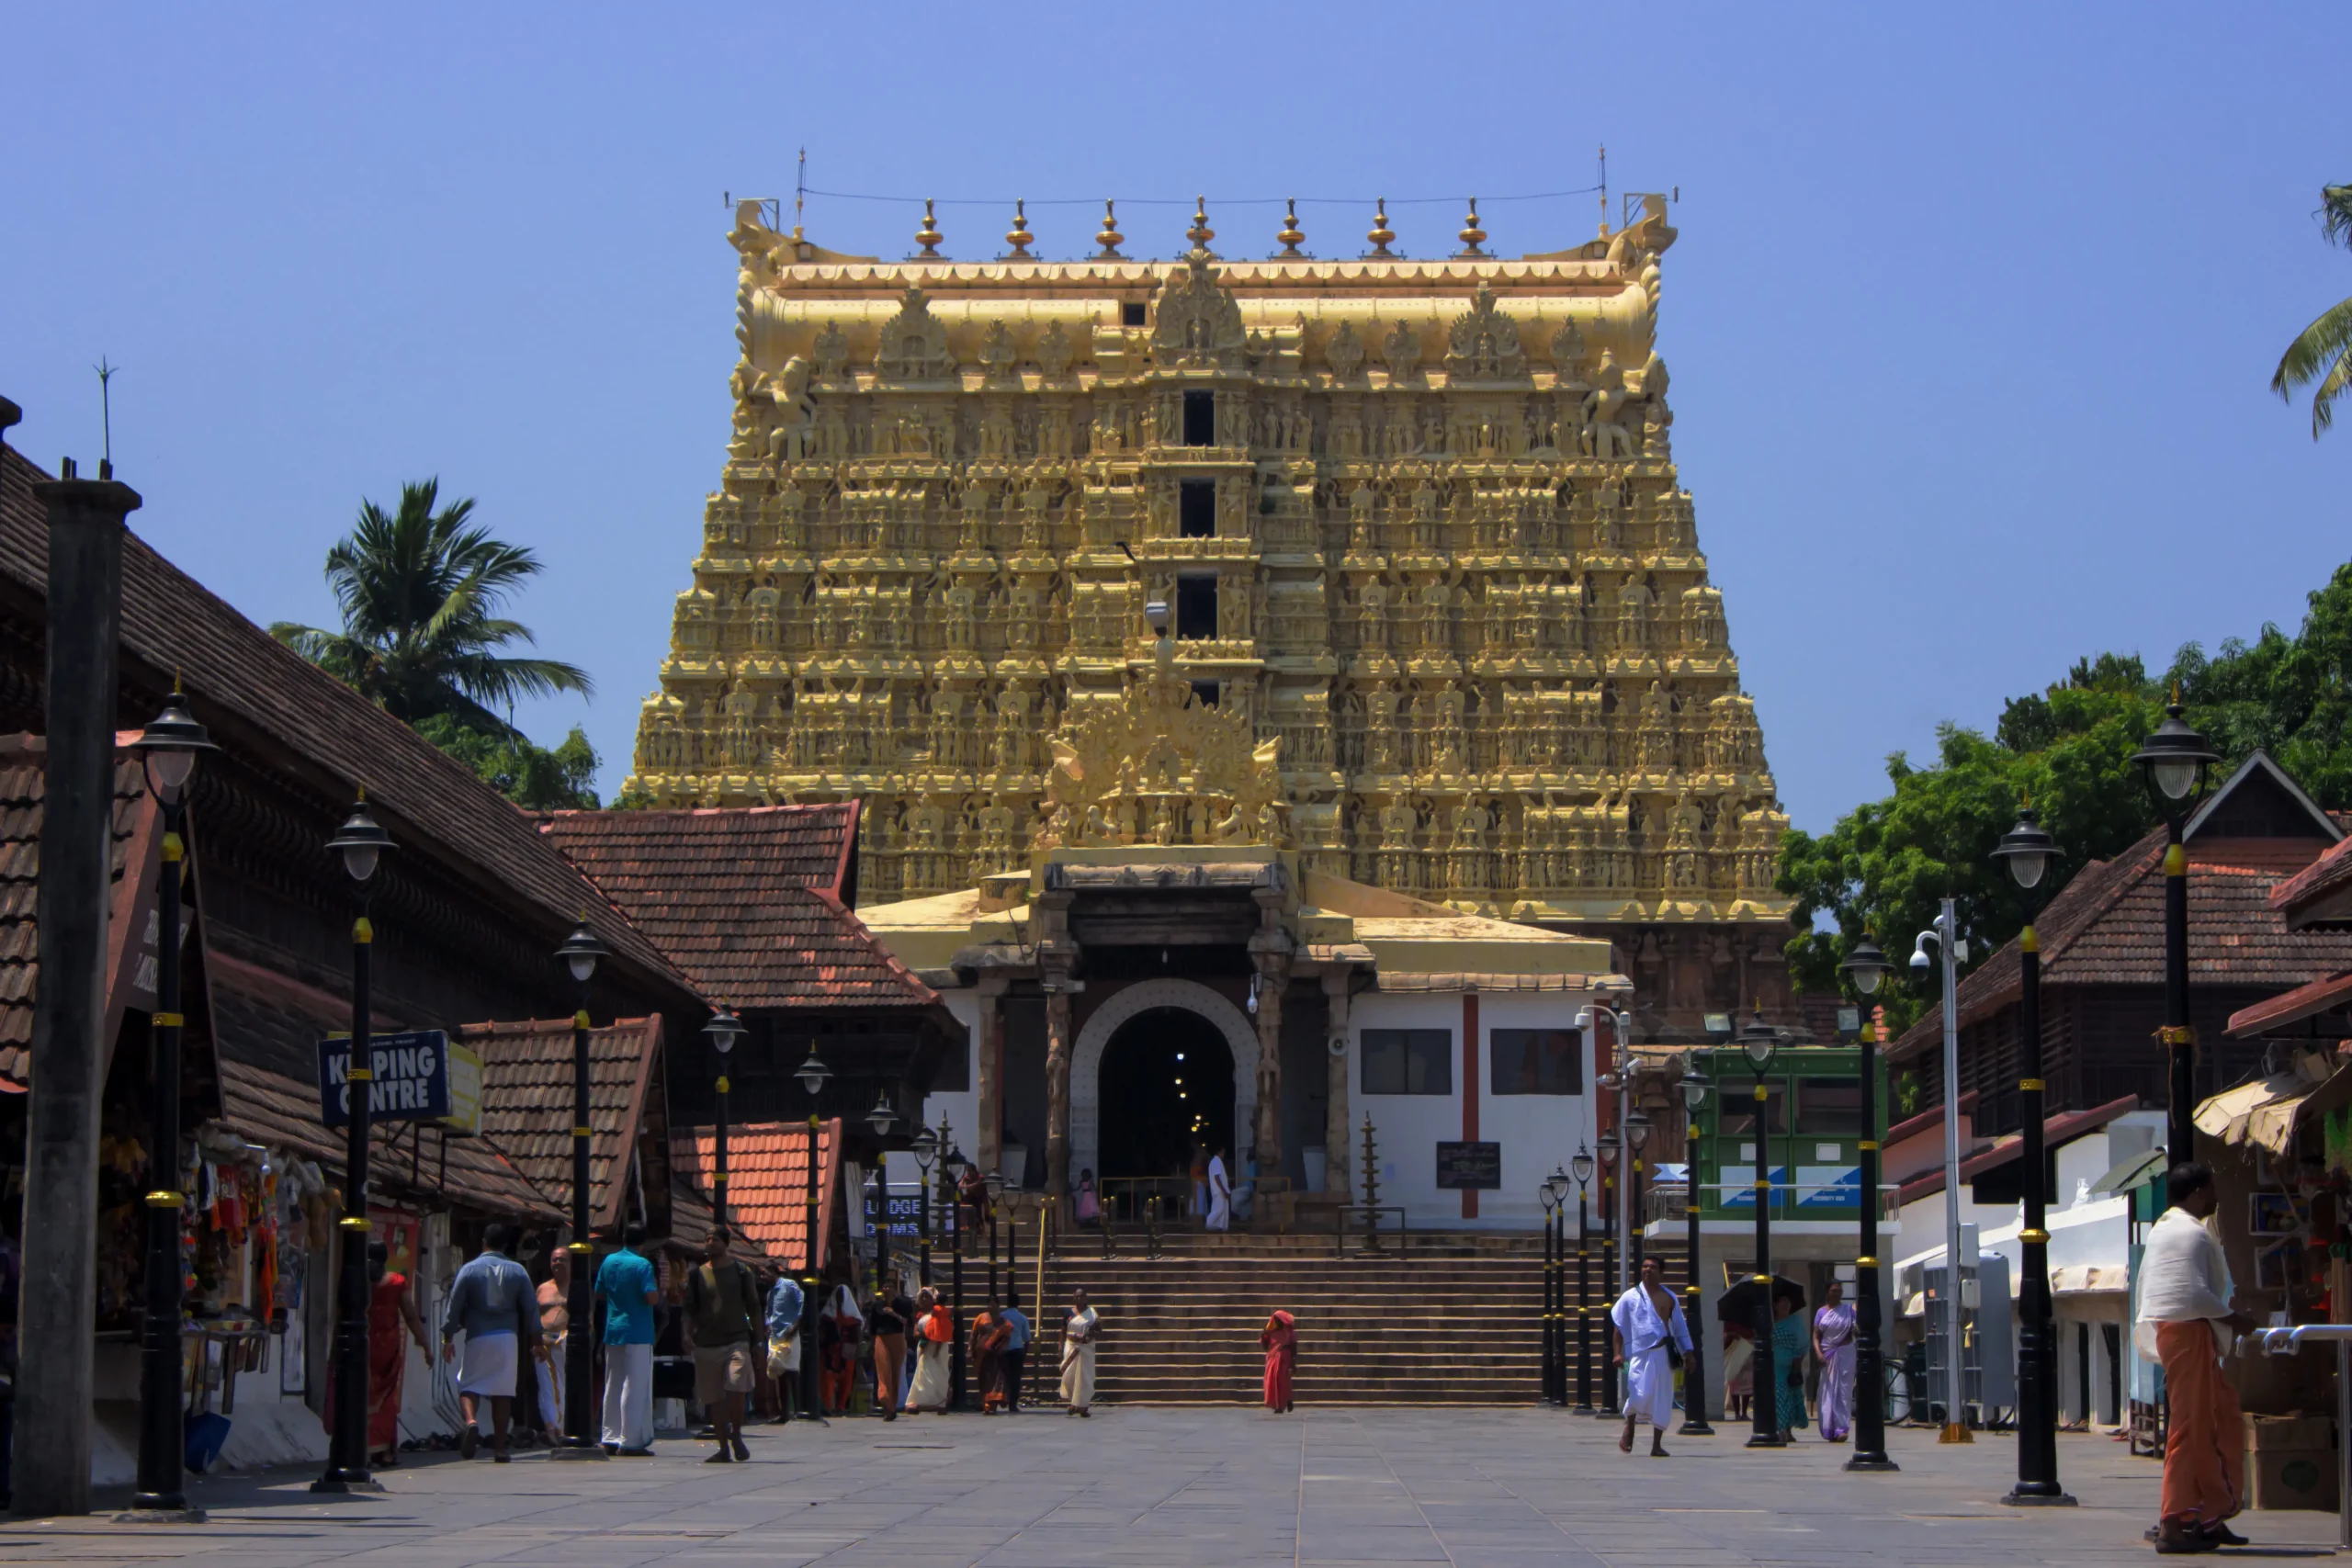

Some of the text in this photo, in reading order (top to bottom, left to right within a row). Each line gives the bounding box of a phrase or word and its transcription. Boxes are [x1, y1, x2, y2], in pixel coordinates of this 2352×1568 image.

[328, 1046, 436, 1085] KPING
[339, 1077, 429, 1115] CNTRE
[865, 1199, 922, 1214] LDGE
